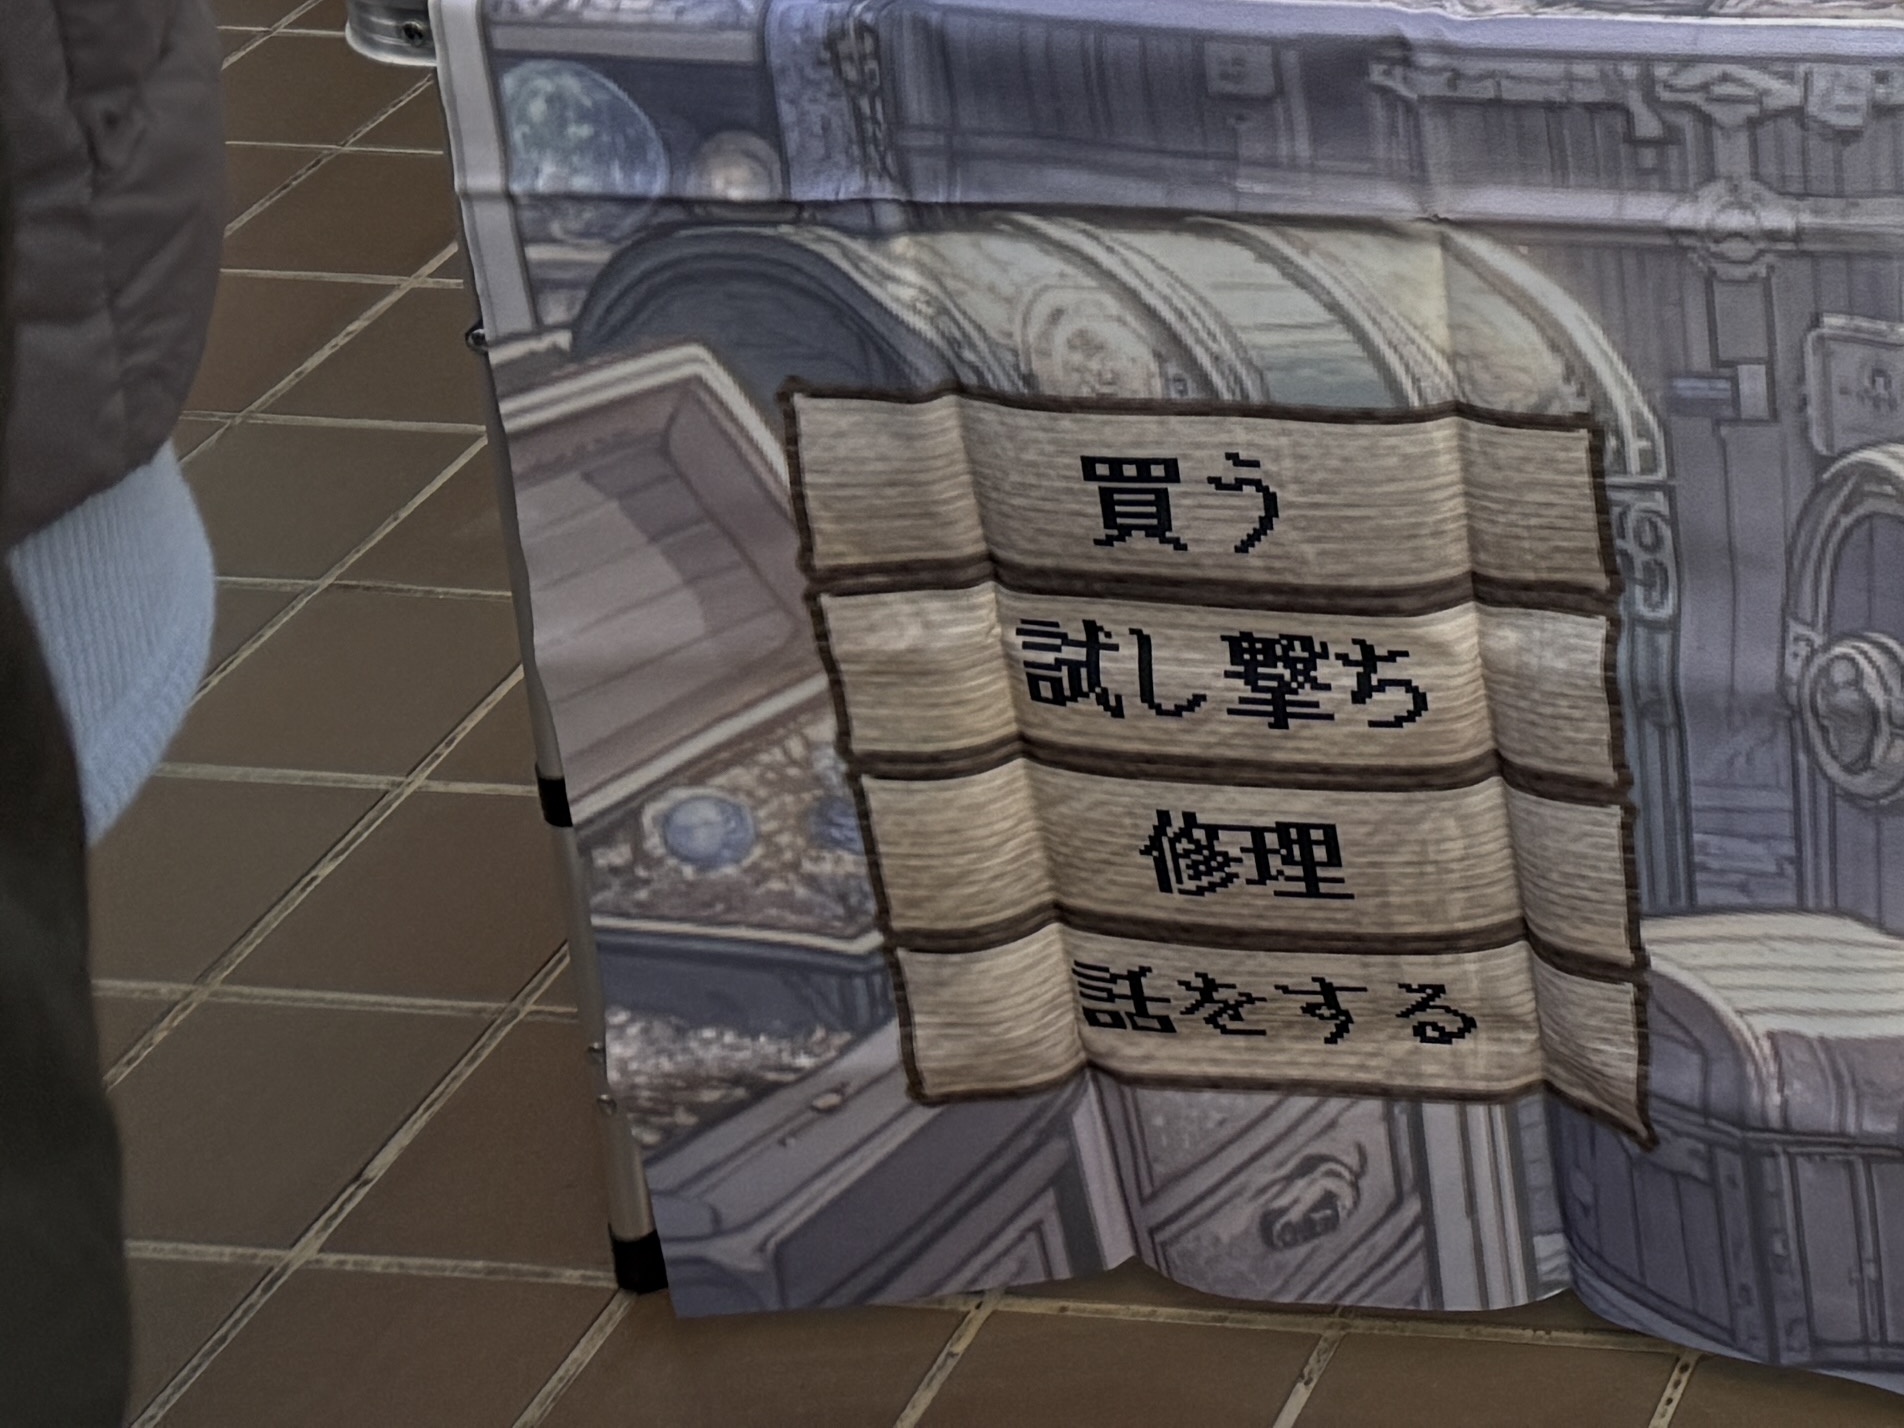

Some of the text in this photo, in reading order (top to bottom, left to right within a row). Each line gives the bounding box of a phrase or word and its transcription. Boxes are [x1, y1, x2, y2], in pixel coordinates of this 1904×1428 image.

[1080, 451, 1281, 555] 買う
[1016, 618, 1430, 730] 試し撃ち
[1139, 808, 1356, 900] 修理
[1071, 959, 1479, 1046] 話をする
